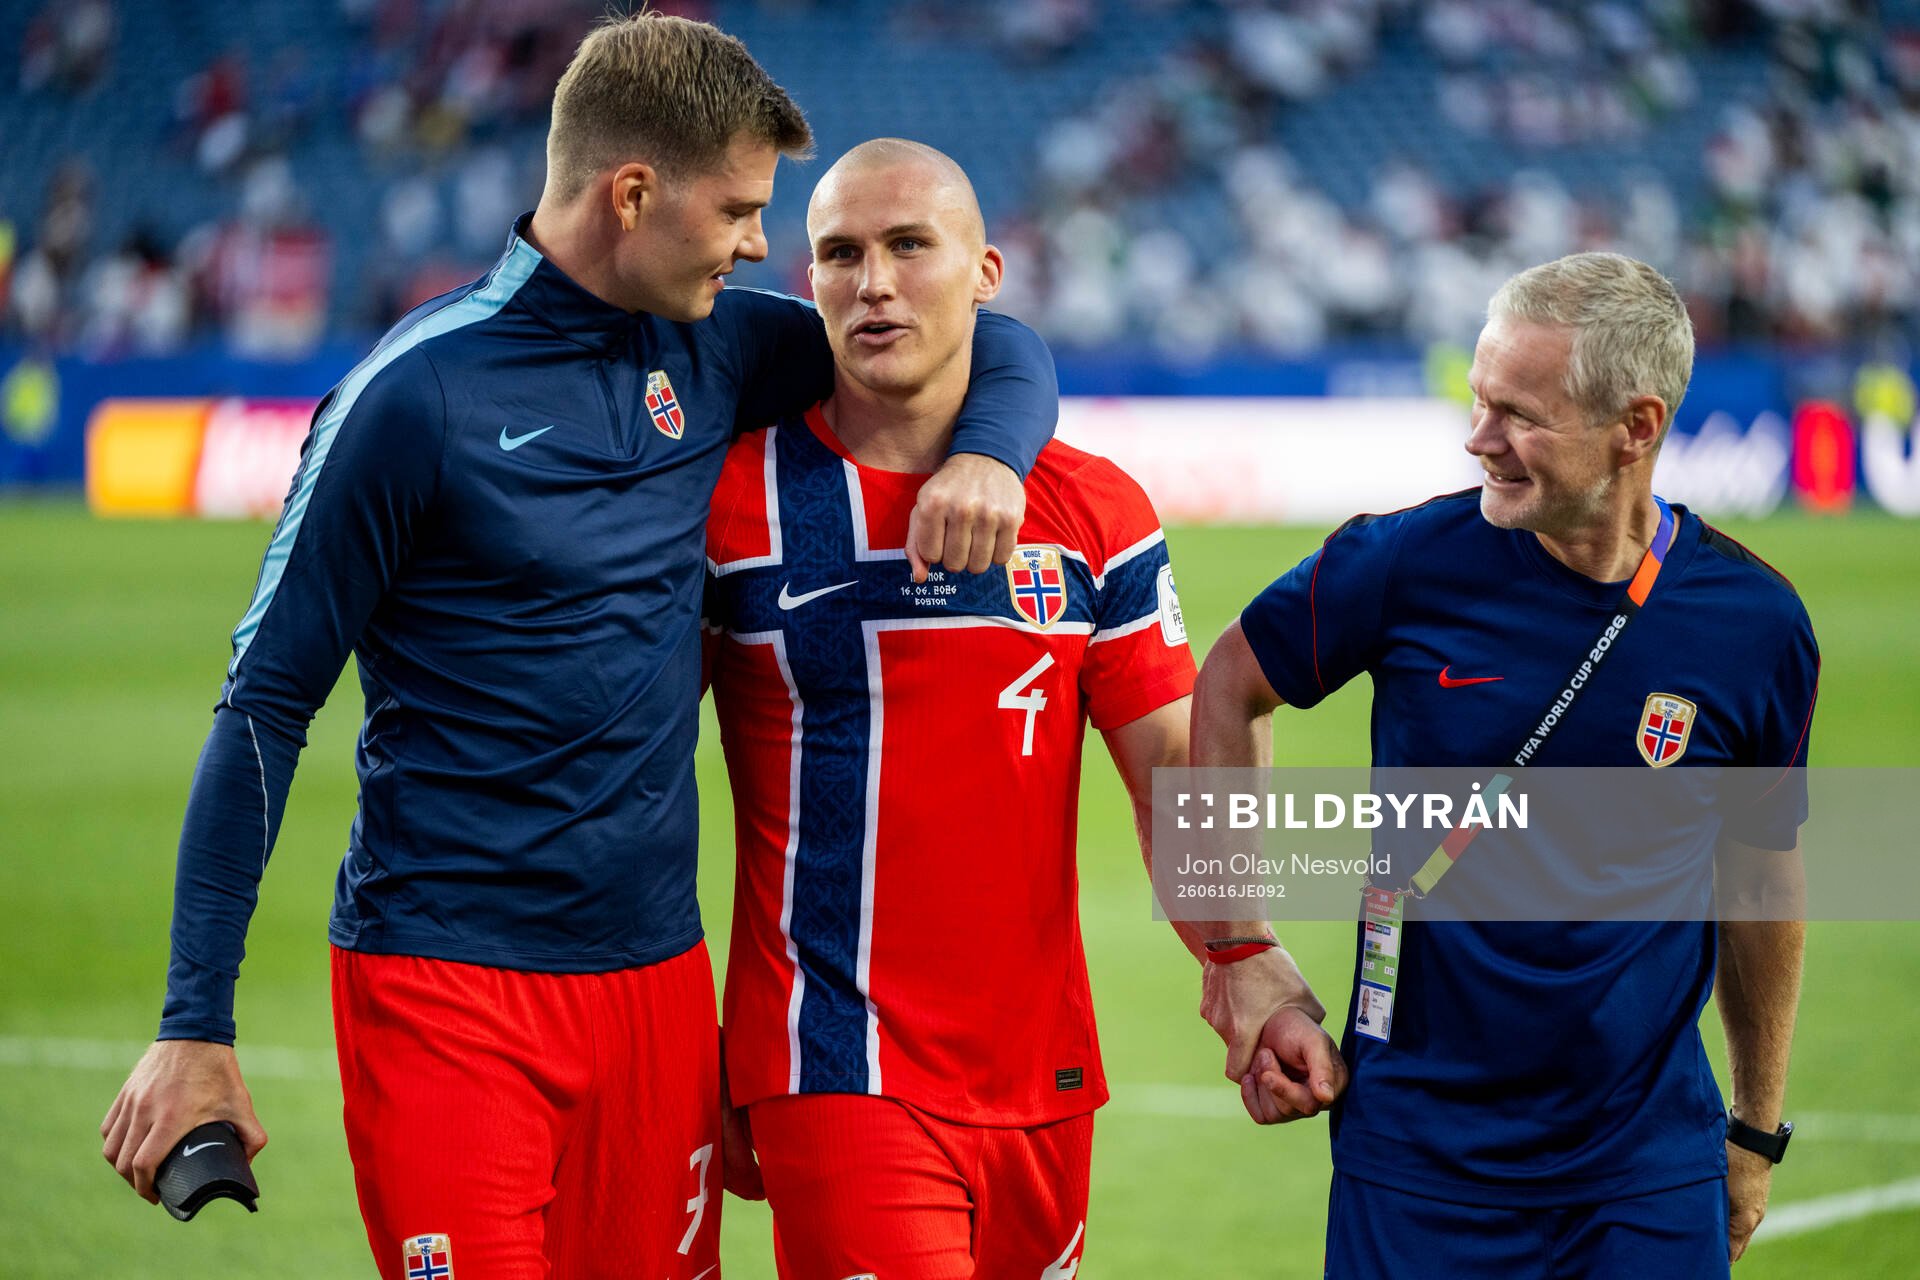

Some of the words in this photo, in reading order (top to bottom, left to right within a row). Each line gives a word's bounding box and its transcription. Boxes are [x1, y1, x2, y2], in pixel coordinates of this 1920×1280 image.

[998, 651, 1055, 756] 4
[1514, 737, 1542, 766] FIFA
[1535, 688, 1575, 737] WORLD
[1570, 661, 1593, 690] CUP
[1589, 614, 1627, 664] 2026
[677, 1143, 713, 1255] 7
